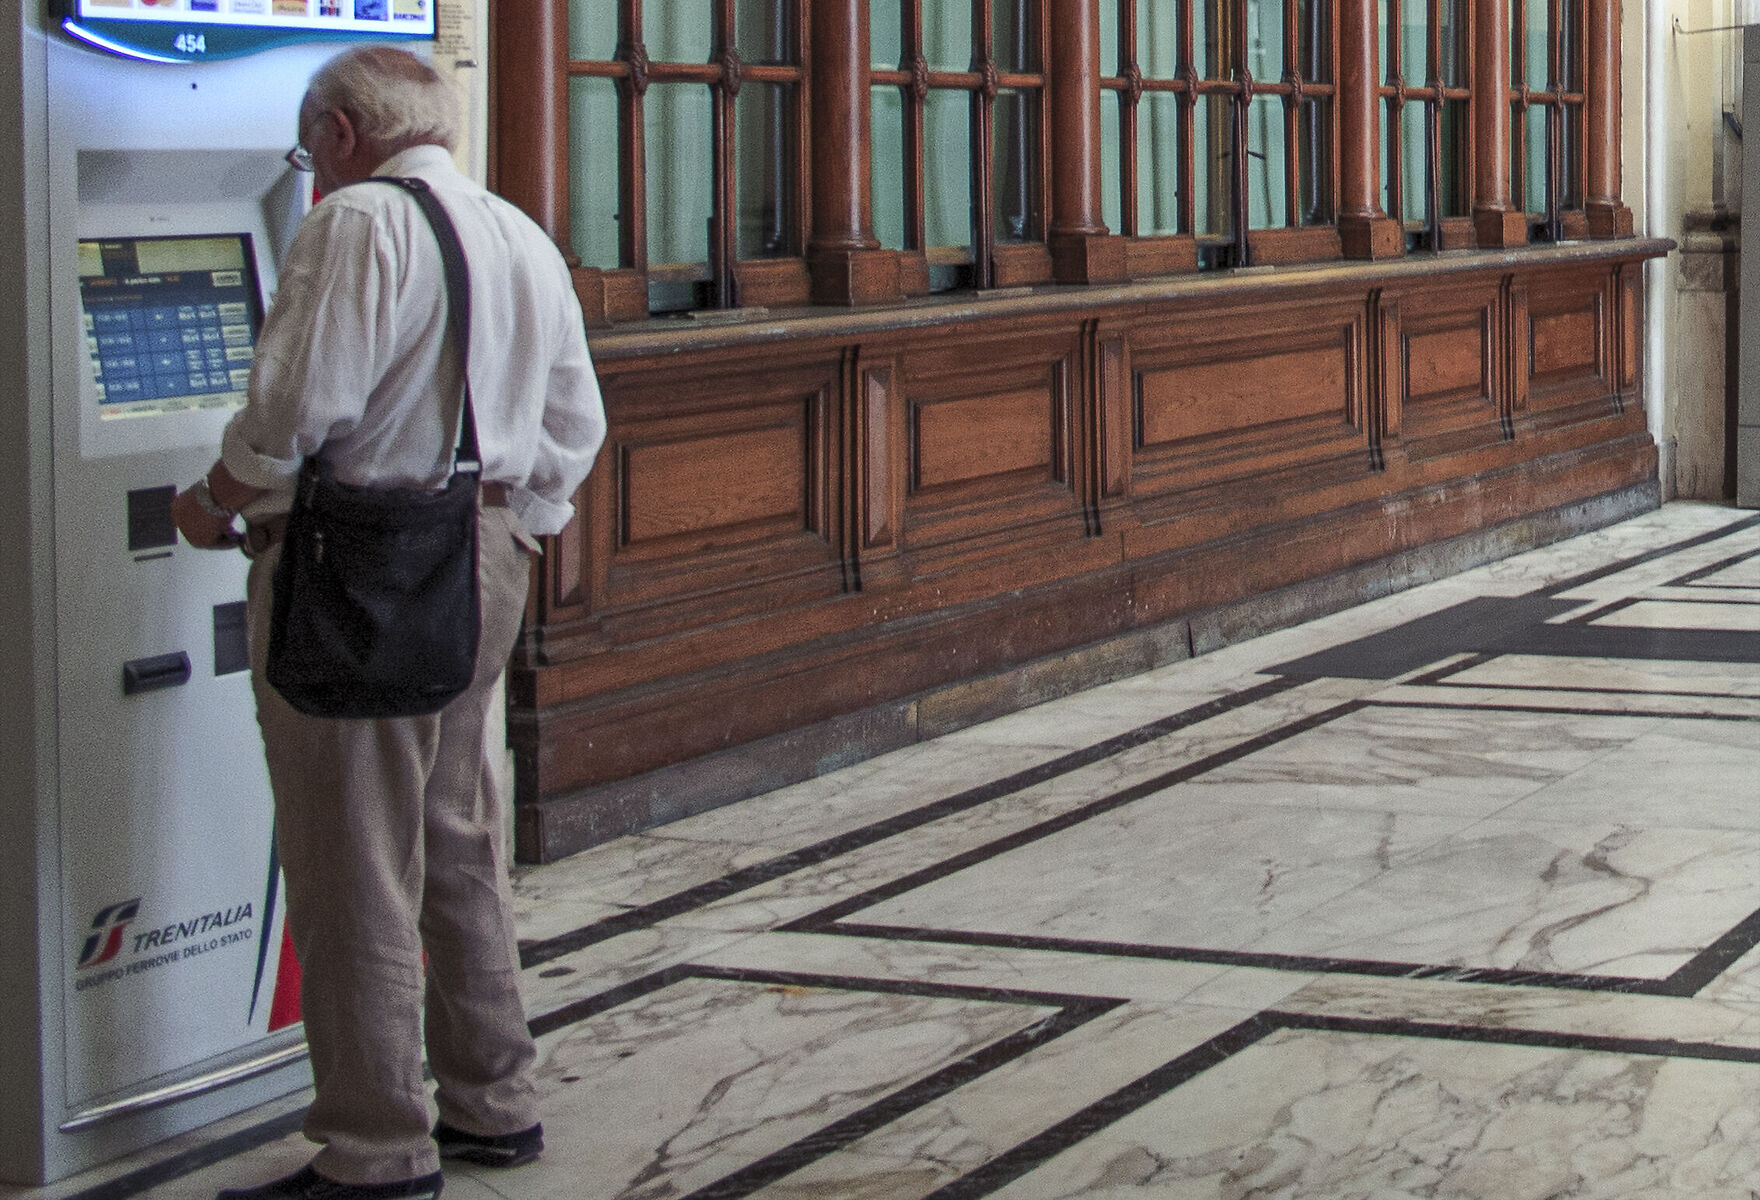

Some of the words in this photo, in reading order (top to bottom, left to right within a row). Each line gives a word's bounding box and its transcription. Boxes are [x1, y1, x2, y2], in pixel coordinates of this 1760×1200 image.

[174, 33, 206, 53] 454
[133, 902, 253, 953] TRENITALIA
[184, 941, 218, 960] DELLO
[220, 929, 253, 947] STATO
